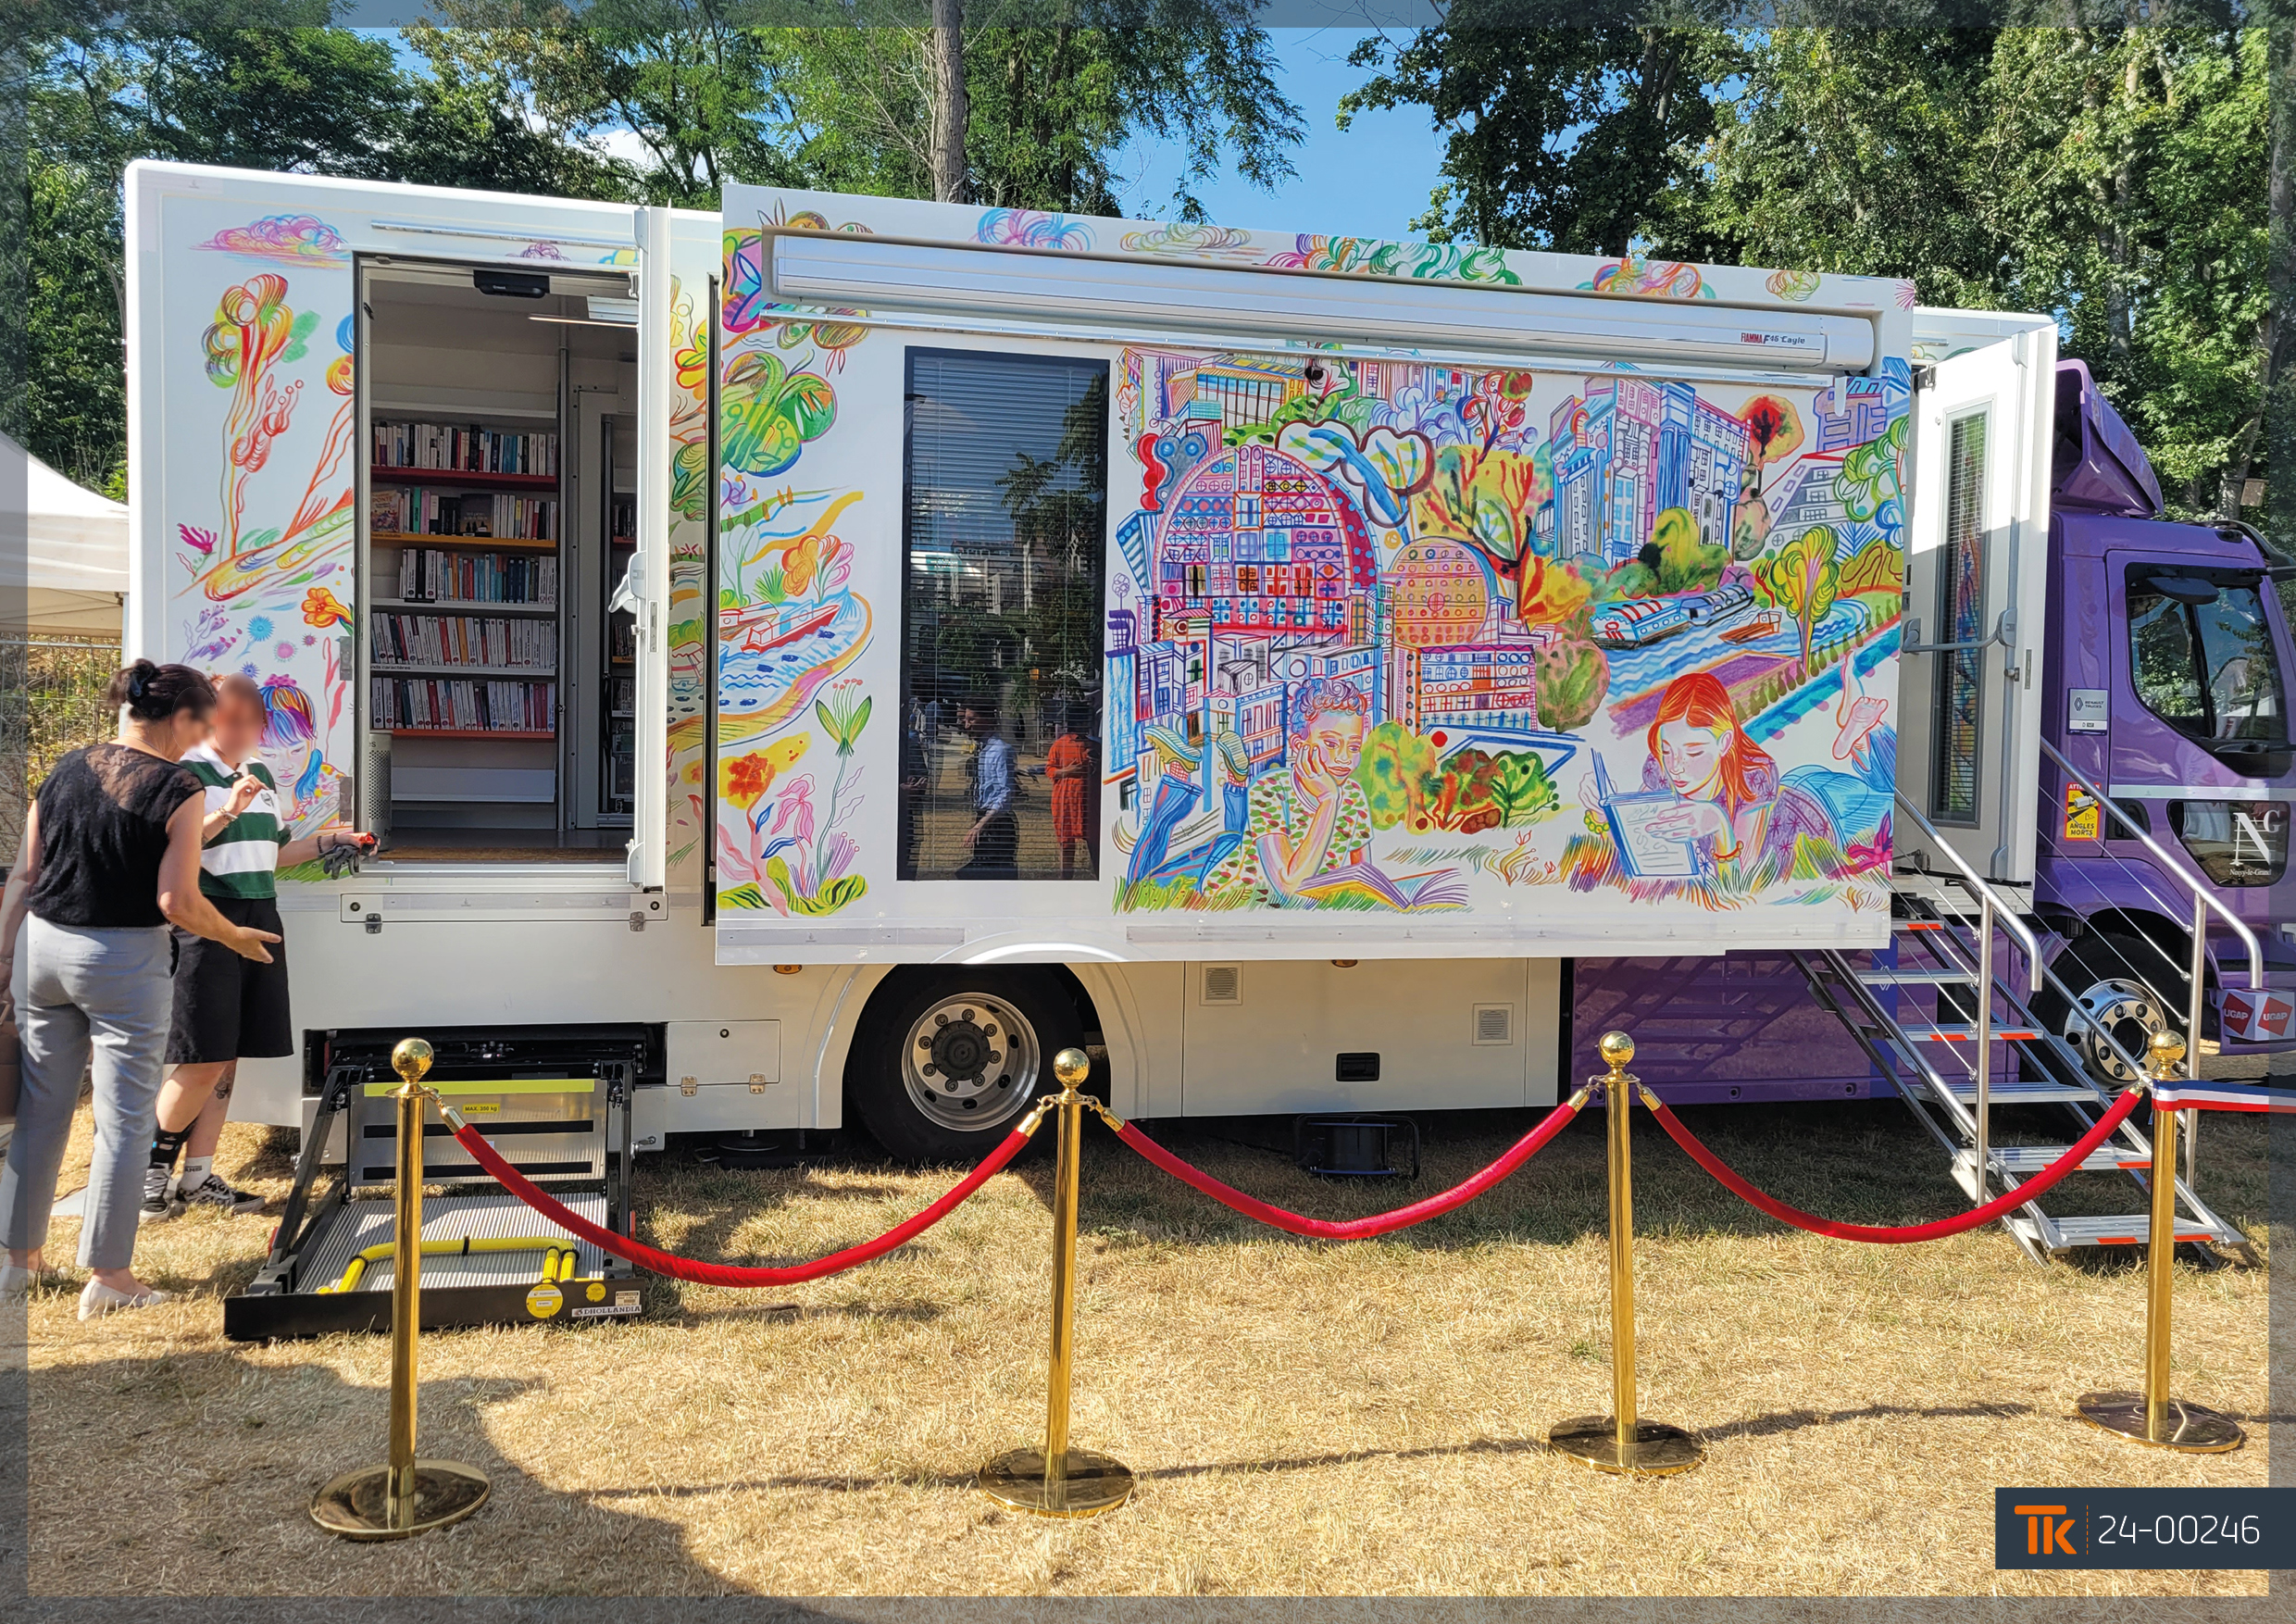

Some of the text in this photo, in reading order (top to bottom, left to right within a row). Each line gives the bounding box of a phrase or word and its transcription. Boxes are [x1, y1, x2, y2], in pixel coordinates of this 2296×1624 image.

[1741, 332, 1763, 344] FIAMMA
[1781, 335, 1805, 345] Eagle
[2229, 868, 2272, 878] Noisy-le-Grand
[2224, 1008, 2249, 1019] UGAP
[2263, 1012, 2288, 1021] UGAP
[584, 1305, 641, 1315] DHOLLANDIA
